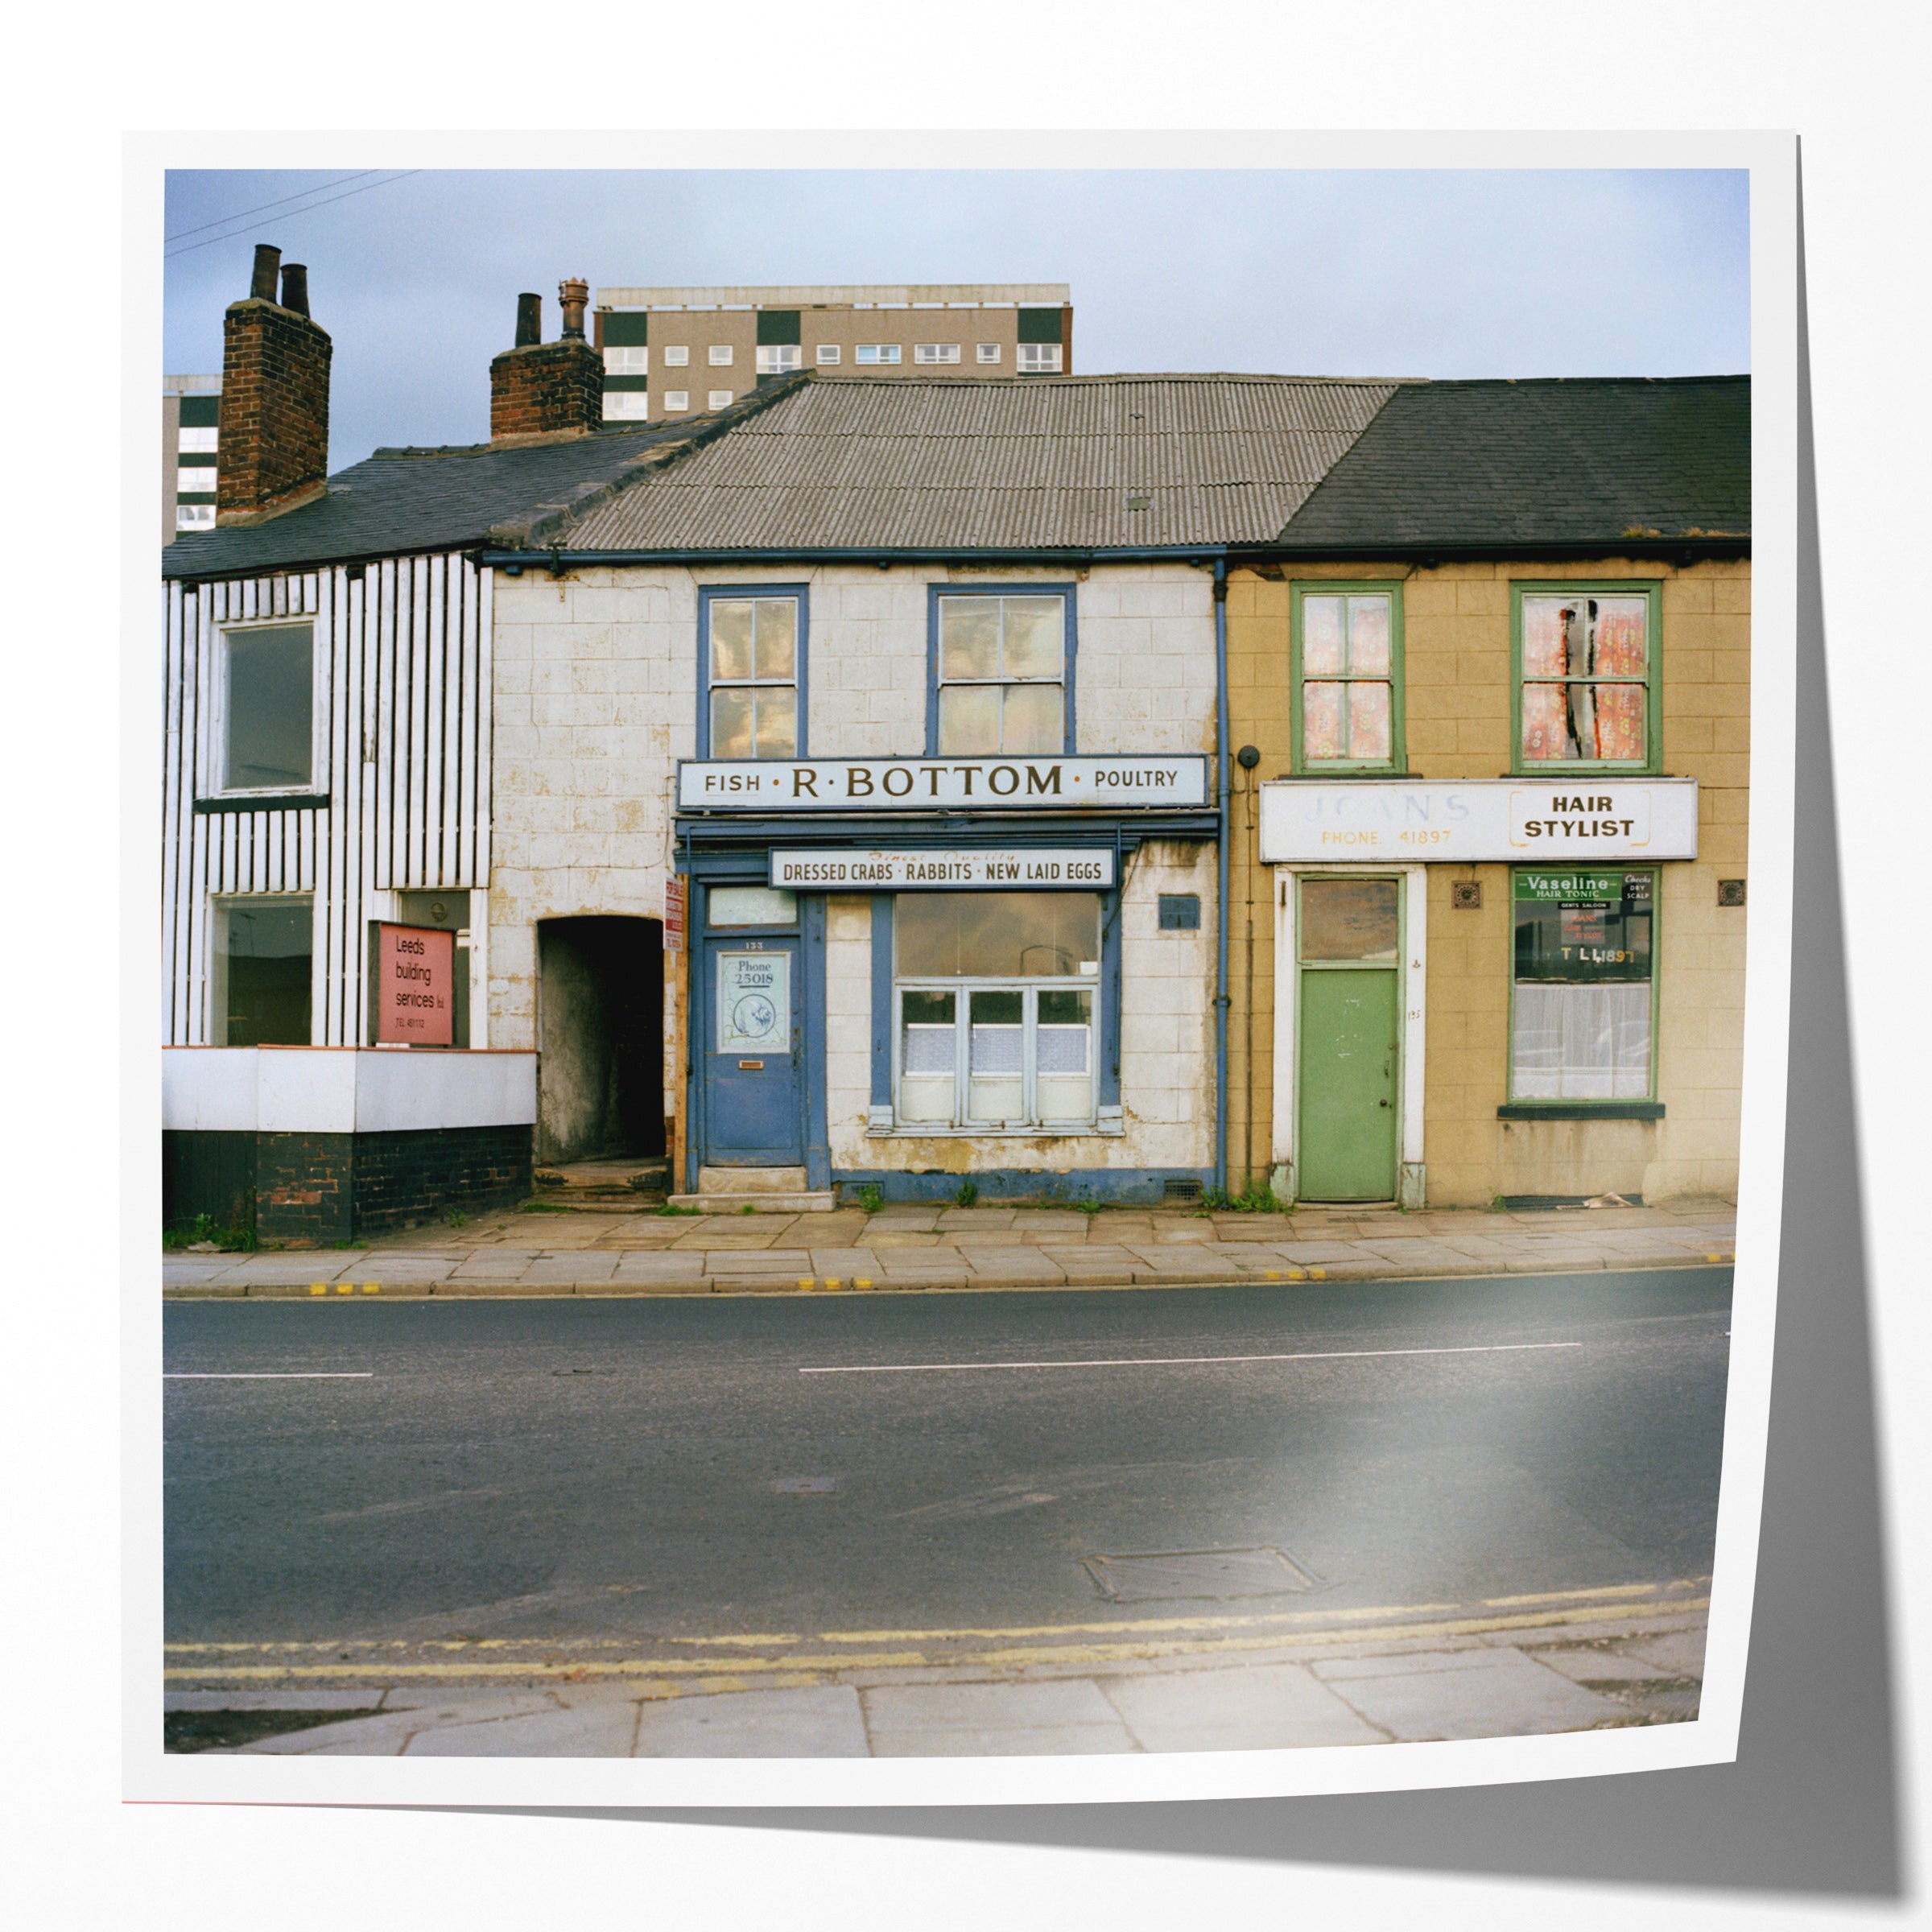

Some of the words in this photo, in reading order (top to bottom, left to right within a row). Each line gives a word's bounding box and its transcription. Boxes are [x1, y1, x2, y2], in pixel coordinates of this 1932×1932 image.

[705, 775, 760, 791] FISH
[792, 769, 819, 797] R
[846, 766, 1063, 796] BOTTOM
[1095, 770, 1178, 787] POULTRY
[1553, 797, 1613, 812] HAIR
[1525, 820, 1634, 837] STYLIST
[1399, 831, 1451, 844] 41897
[784, 864, 845, 881] DRESSED
[851, 864, 893, 880] CRABS
[906, 863, 972, 880] RABBITS
[986, 863, 1020, 880] NEW
[1027, 863, 1060, 879] LAID
[1067, 863, 1102, 879] EGGS
[1527, 876, 1608, 890] Vaseline
[396, 935, 424, 956] Leeds
[745, 941, 764, 950] 133
[396, 960, 431, 986] building
[738, 960, 771, 972] Phone
[735, 972, 774, 985] 25018
[396, 990, 435, 1008] services
[395, 1017, 405, 1028] TEL
